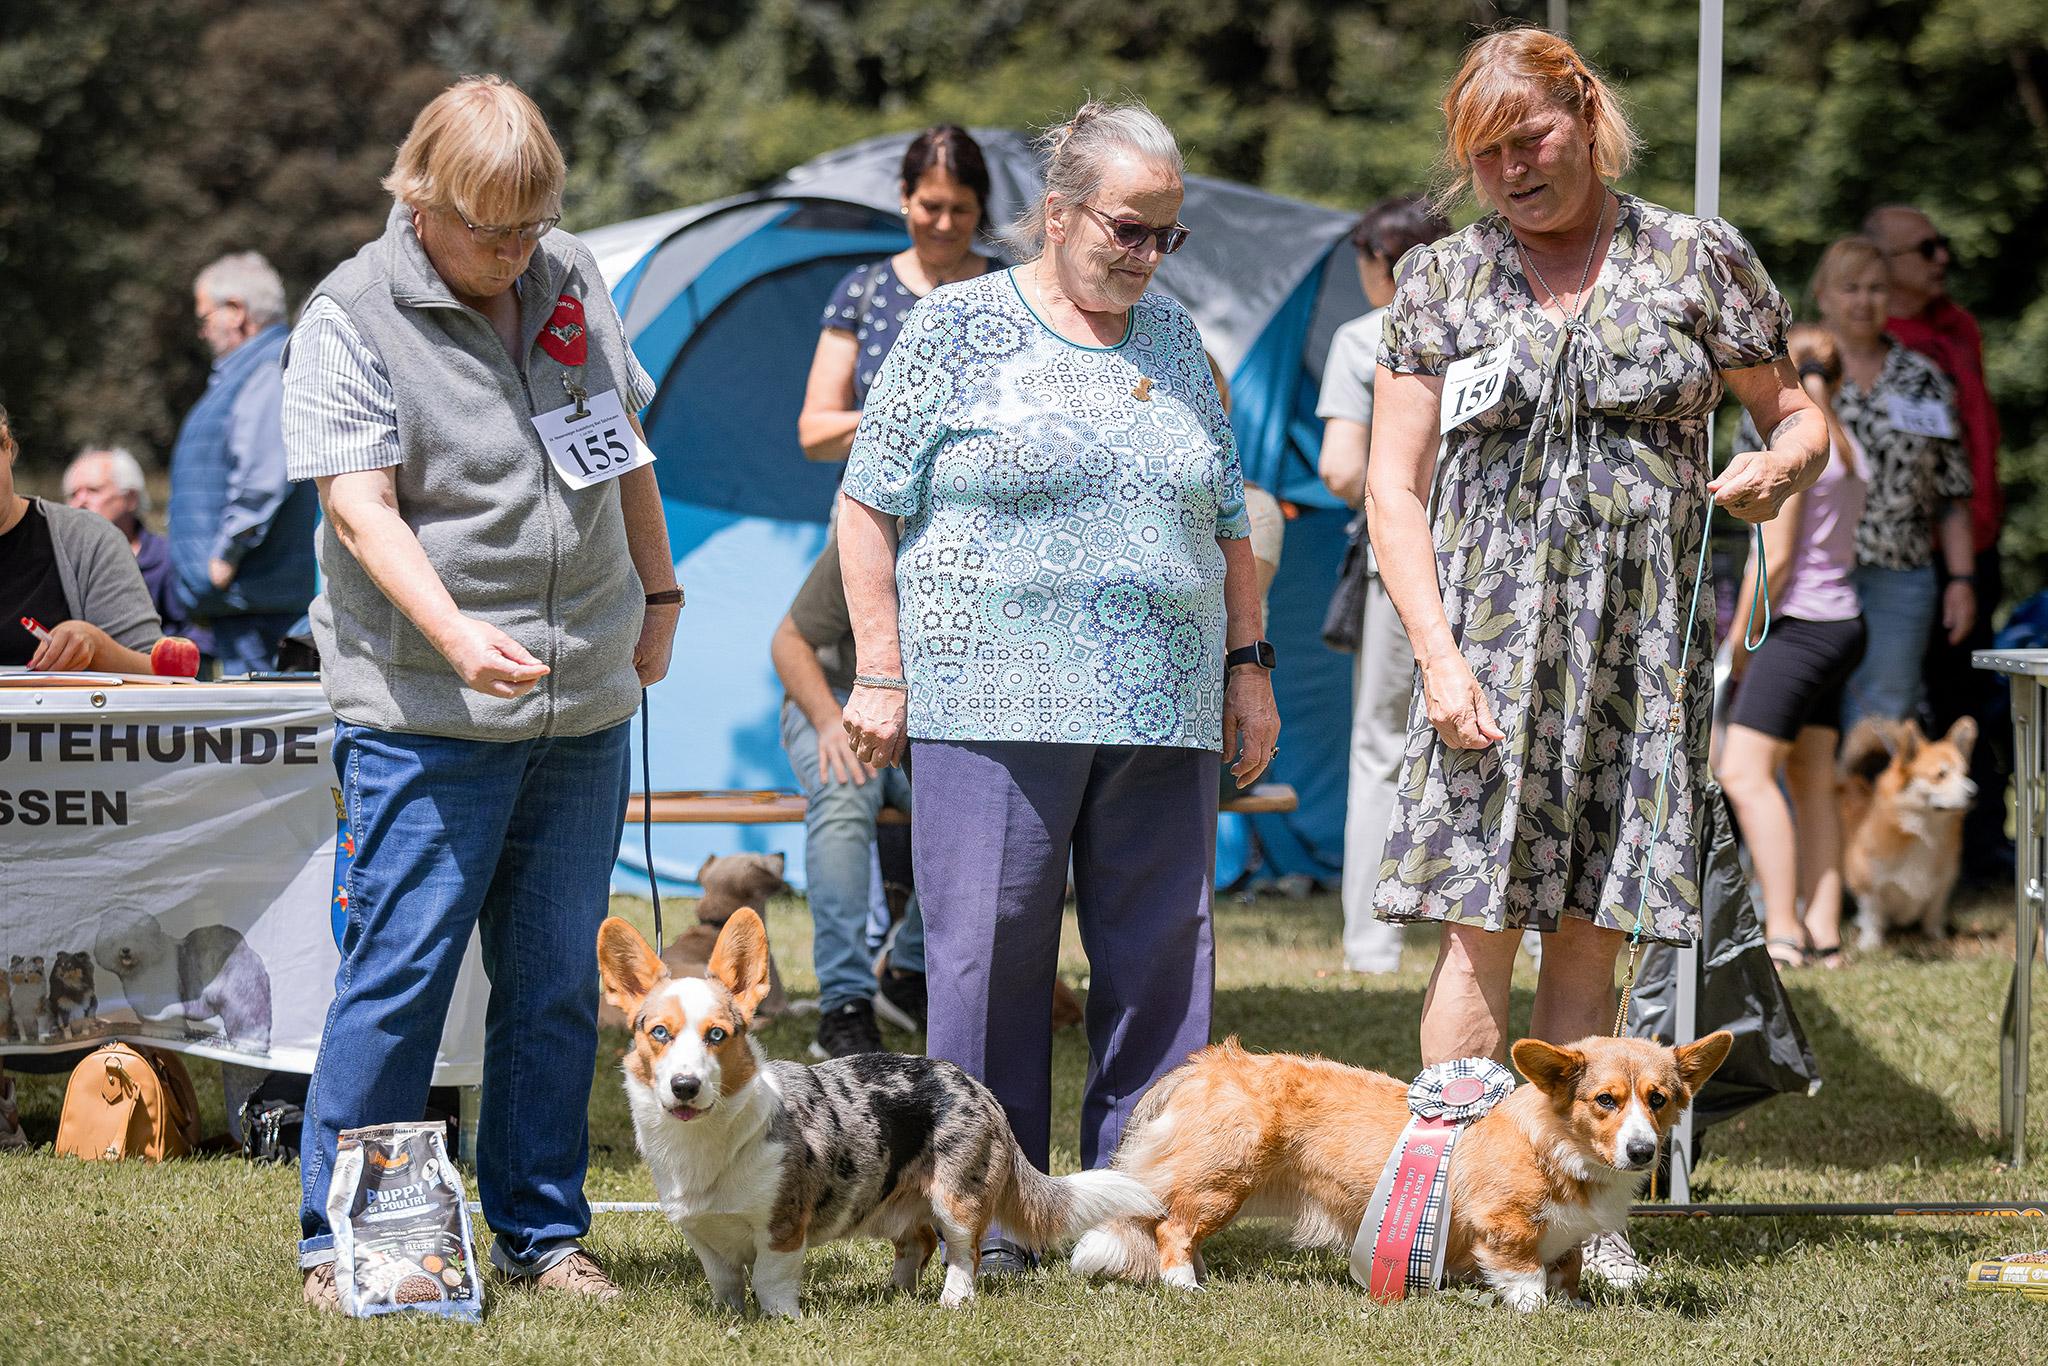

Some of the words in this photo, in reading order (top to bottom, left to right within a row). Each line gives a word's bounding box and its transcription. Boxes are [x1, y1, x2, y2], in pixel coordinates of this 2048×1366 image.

[1450, 373, 1499, 419] 159
[565, 428, 630, 478] 155
[366, 1181, 424, 1205] PUPPY
[1413, 1174, 1426, 1195] BEST
[380, 1194, 427, 1212] POULTRY
[1410, 1197, 1418, 1210] OF
[1399, 1211, 1414, 1240] BREED
[405, 1242, 435, 1250] FLEISCH
